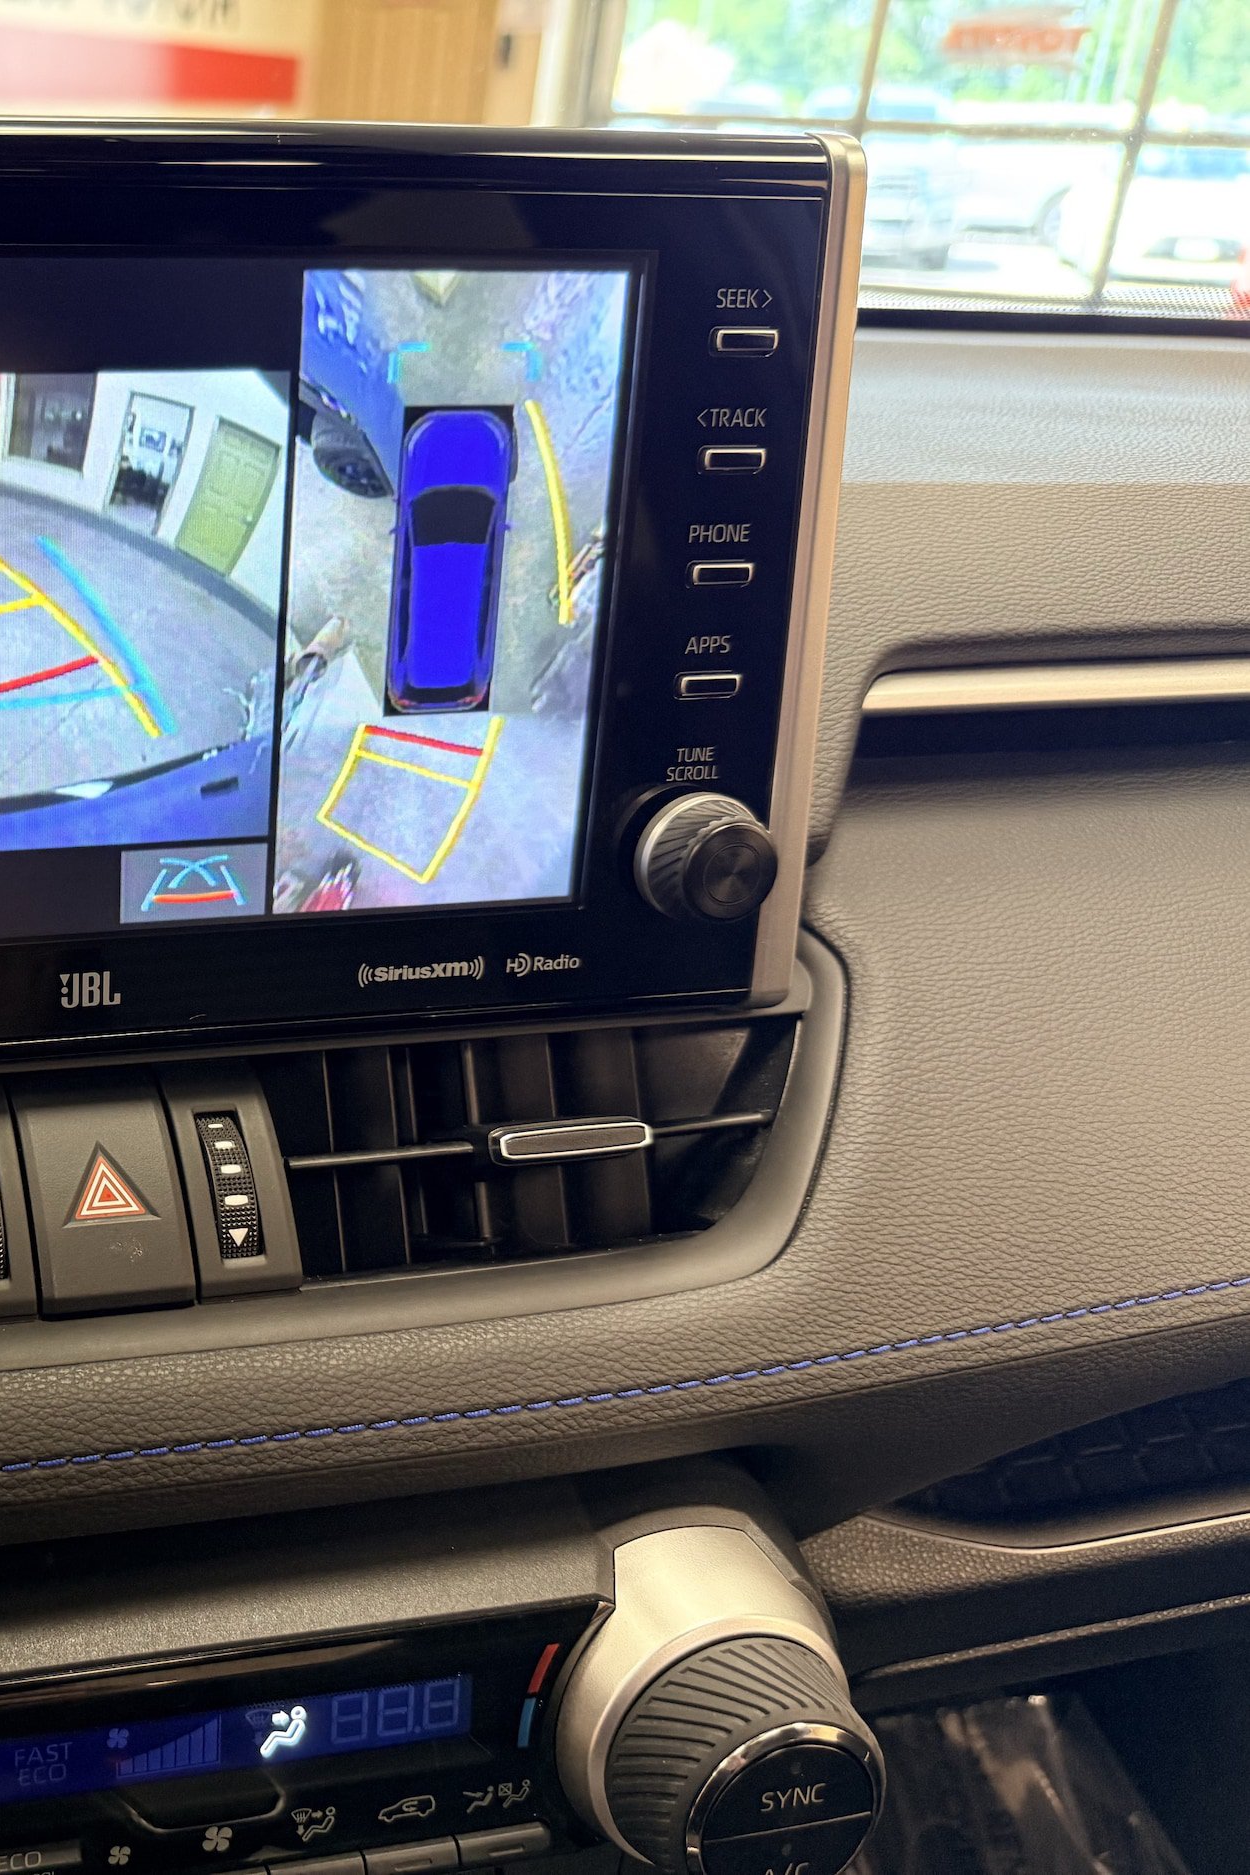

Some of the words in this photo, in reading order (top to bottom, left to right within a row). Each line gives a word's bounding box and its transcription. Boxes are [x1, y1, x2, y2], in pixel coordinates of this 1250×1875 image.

[688, 523, 751, 543] PHONE
[685, 635, 731, 655] APPS
[676, 746, 716, 763] TUNE
[666, 764, 719, 782] SCROLL
[533, 954, 581, 971] Radio
[59, 970, 121, 1009] JBL
[14, 1741, 73, 1768] FAST
[18, 1763, 67, 1787] ECO
[760, 1782, 827, 1812] SYNC
